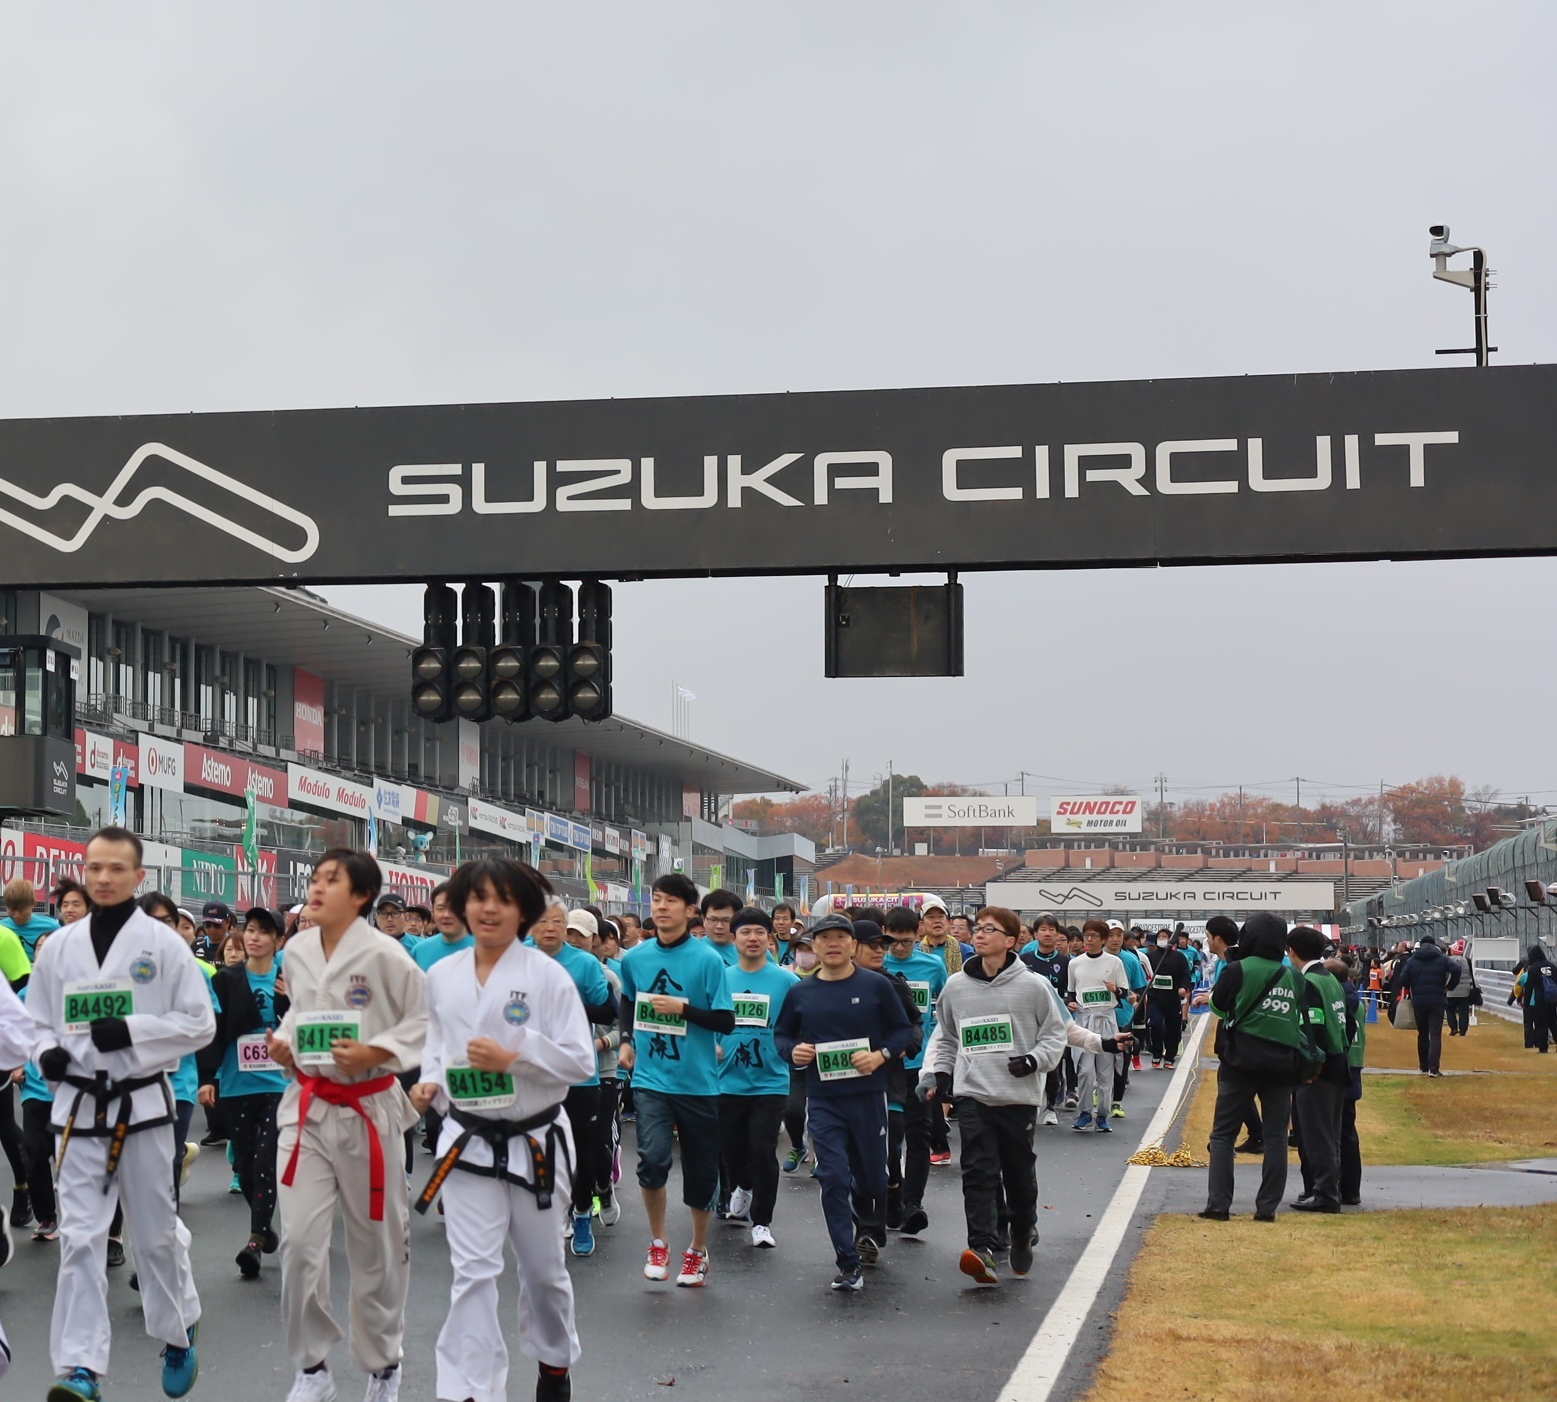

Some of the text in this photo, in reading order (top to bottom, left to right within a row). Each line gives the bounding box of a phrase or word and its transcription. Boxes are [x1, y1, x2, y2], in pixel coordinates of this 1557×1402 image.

[388, 430, 1459, 517] SUZUKA CIRCUIT
[295, 701, 323, 728] HONDA
[158, 754, 176, 776] MUFG
[200, 752, 232, 788] Astemo
[246, 766, 275, 800] Astemo
[298, 775, 367, 810] Modulo Modulo
[947, 804, 1016, 819] SoftBank
[1055, 800, 1137, 815] SUNOCO
[1086, 818, 1128, 828] MOTOR OIL
[1114, 890, 1282, 901] SUZUKA CIRCUIT
[69, 994, 127, 1019] B4492
[734, 1003, 764, 1017] 4126
[1261, 998, 1291, 1014] 999
[965, 1025, 1007, 1044] B4485
[448, 1070, 507, 1095] B4154
